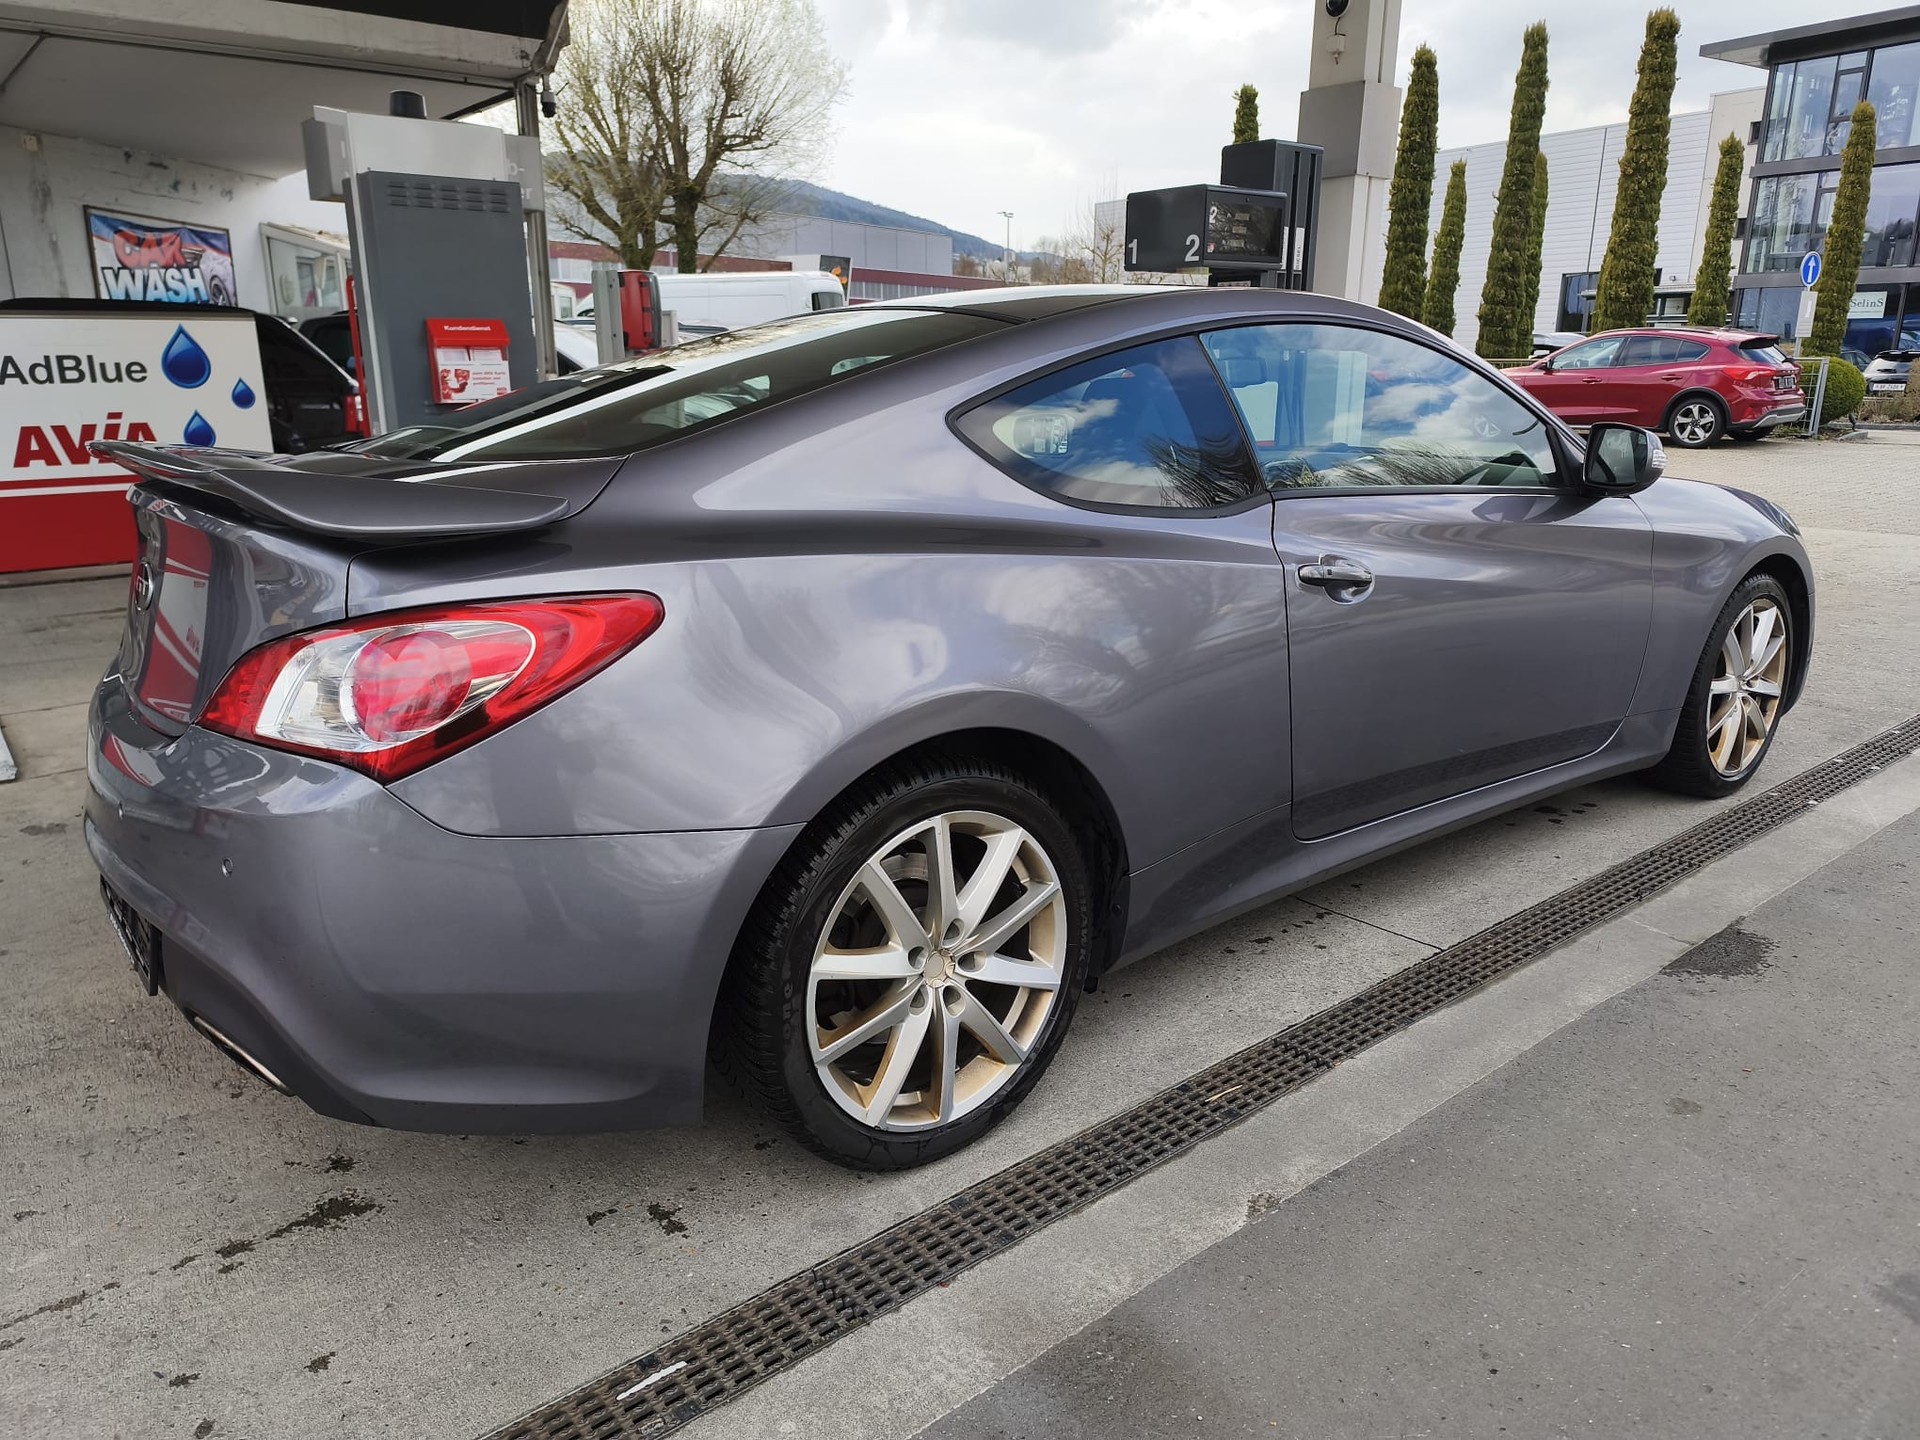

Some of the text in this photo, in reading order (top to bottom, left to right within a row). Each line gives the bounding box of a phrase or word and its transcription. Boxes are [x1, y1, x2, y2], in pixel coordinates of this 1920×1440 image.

[1208, 206, 1218, 224] 2
[1128, 238, 1138, 265] 1
[1184, 234, 1200, 262] 2
[102, 267, 209, 304] WASH
[1850, 297, 1884, 308] SelinS
[0, 354, 148, 385] AdBlue
